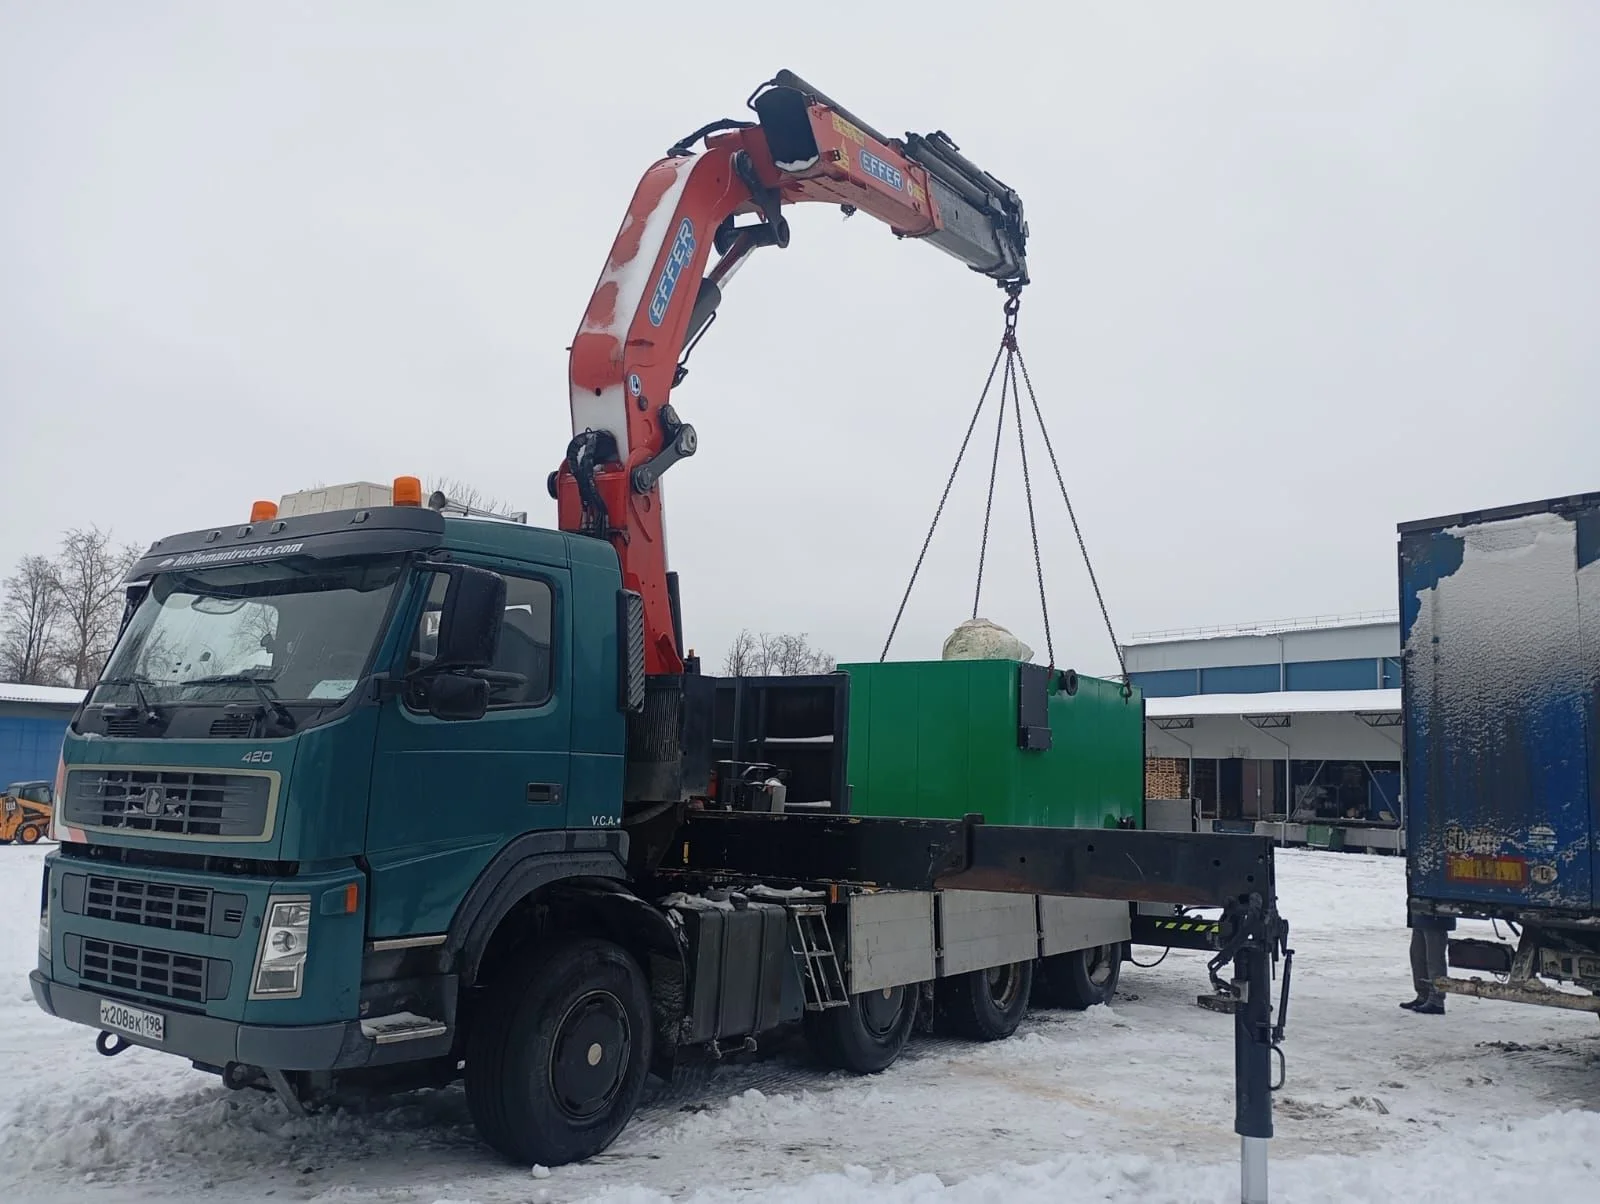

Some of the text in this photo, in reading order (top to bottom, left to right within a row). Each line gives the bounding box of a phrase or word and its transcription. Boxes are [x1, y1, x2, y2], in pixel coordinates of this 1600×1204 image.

[862, 153, 902, 189] EFFER
[652, 223, 692, 319] EFFER
[241, 750, 273, 763] 420
[144, 1015, 161, 1031] 198
